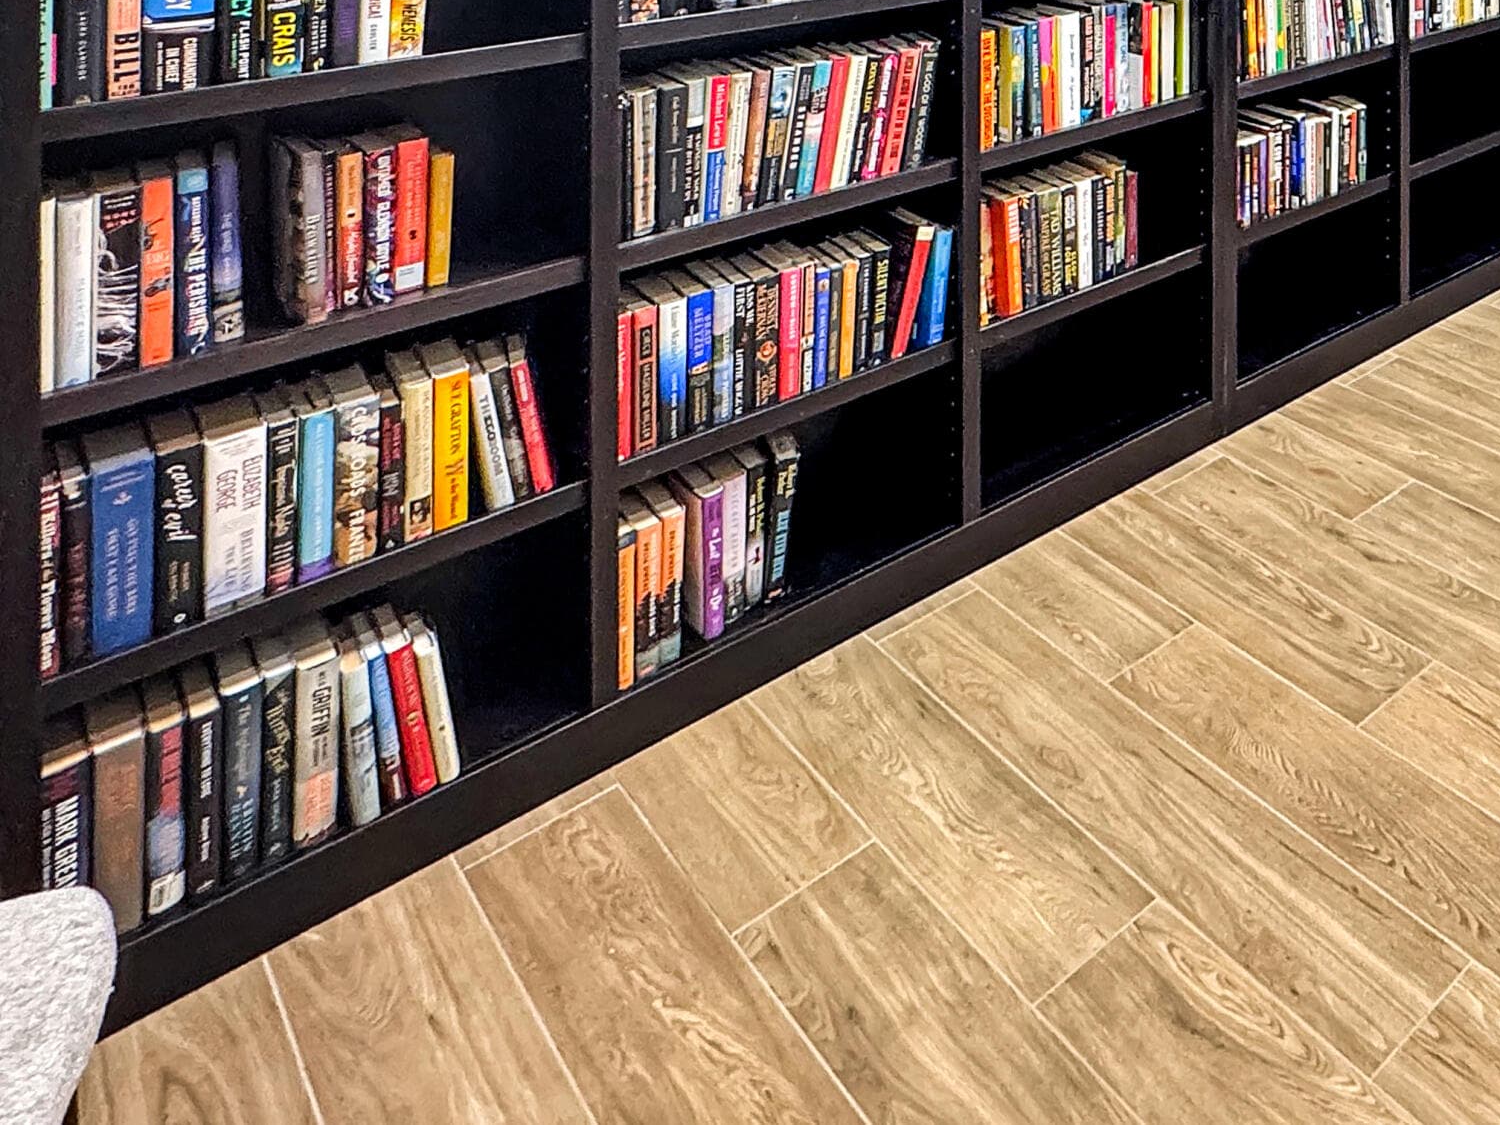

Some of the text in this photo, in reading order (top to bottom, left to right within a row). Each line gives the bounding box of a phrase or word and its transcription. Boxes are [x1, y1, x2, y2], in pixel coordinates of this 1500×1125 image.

[272, 12, 296, 66] CRAIS
[401, 4, 418, 41] NEMESIS
[113, 32, 139, 83] BILL
[165, 48, 179, 83] IN CHIEF
[183, 38, 197, 91] COMMANDER
[238, 21, 250, 78] FLASH POINT
[863, 62, 878, 113] DONNA LEON
[923, 73, 932, 92] GOD
[714, 83, 725, 145] Michael Lewis
[790, 106, 806, 169] STRANDED
[914, 118, 926, 150] WOODS
[1041, 214, 1050, 251] EMPIRE
[1050, 211, 1062, 296] TAD WILLIAMS
[187, 251, 207, 334] THE PERISHING
[735, 286, 745, 318] FIRST
[874, 259, 889, 324] SILENT VICTIM
[1041, 264, 1051, 296] GRASS
[671, 306, 679, 328] Liane
[694, 307, 704, 358] MELTZER
[350, 407, 365, 497] CROSSROADS
[451, 404, 462, 455] GRAFTON
[163, 464, 197, 541] career evil
[216, 470, 238, 513] GEORGE
[242, 455, 262, 510] ELIZABETH
[40, 512, 58, 672] Killers Flower Moon
[311, 686, 332, 737] GRIFFIN
[55, 795, 79, 846] MARK
